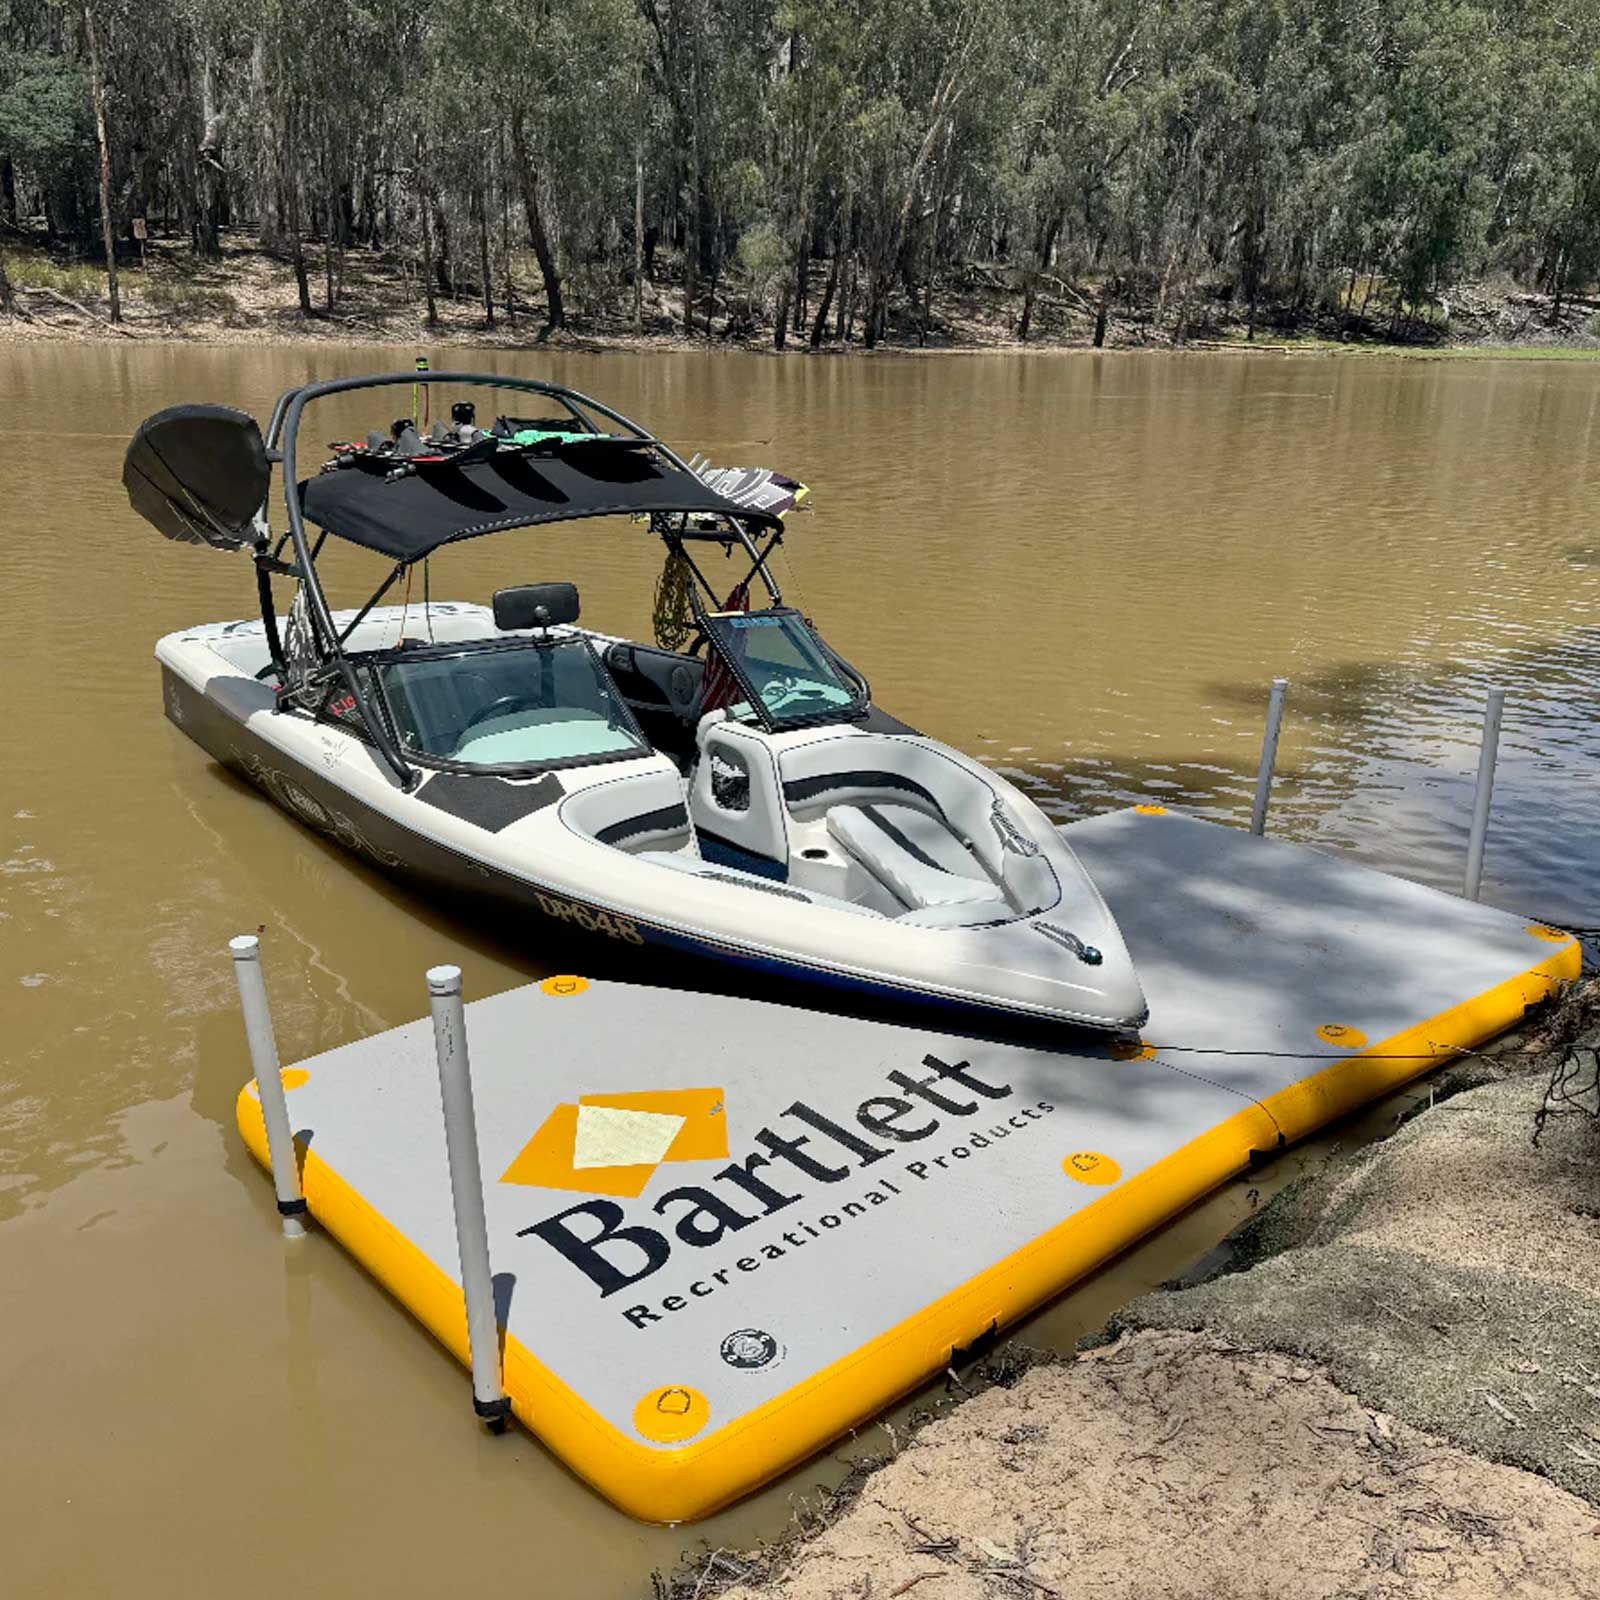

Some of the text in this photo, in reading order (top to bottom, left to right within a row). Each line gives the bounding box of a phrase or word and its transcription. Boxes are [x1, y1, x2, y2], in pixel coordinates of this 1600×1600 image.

[516, 1053, 1014, 1299] Bartlett
[621, 1101, 1056, 1330] Recreational Products
